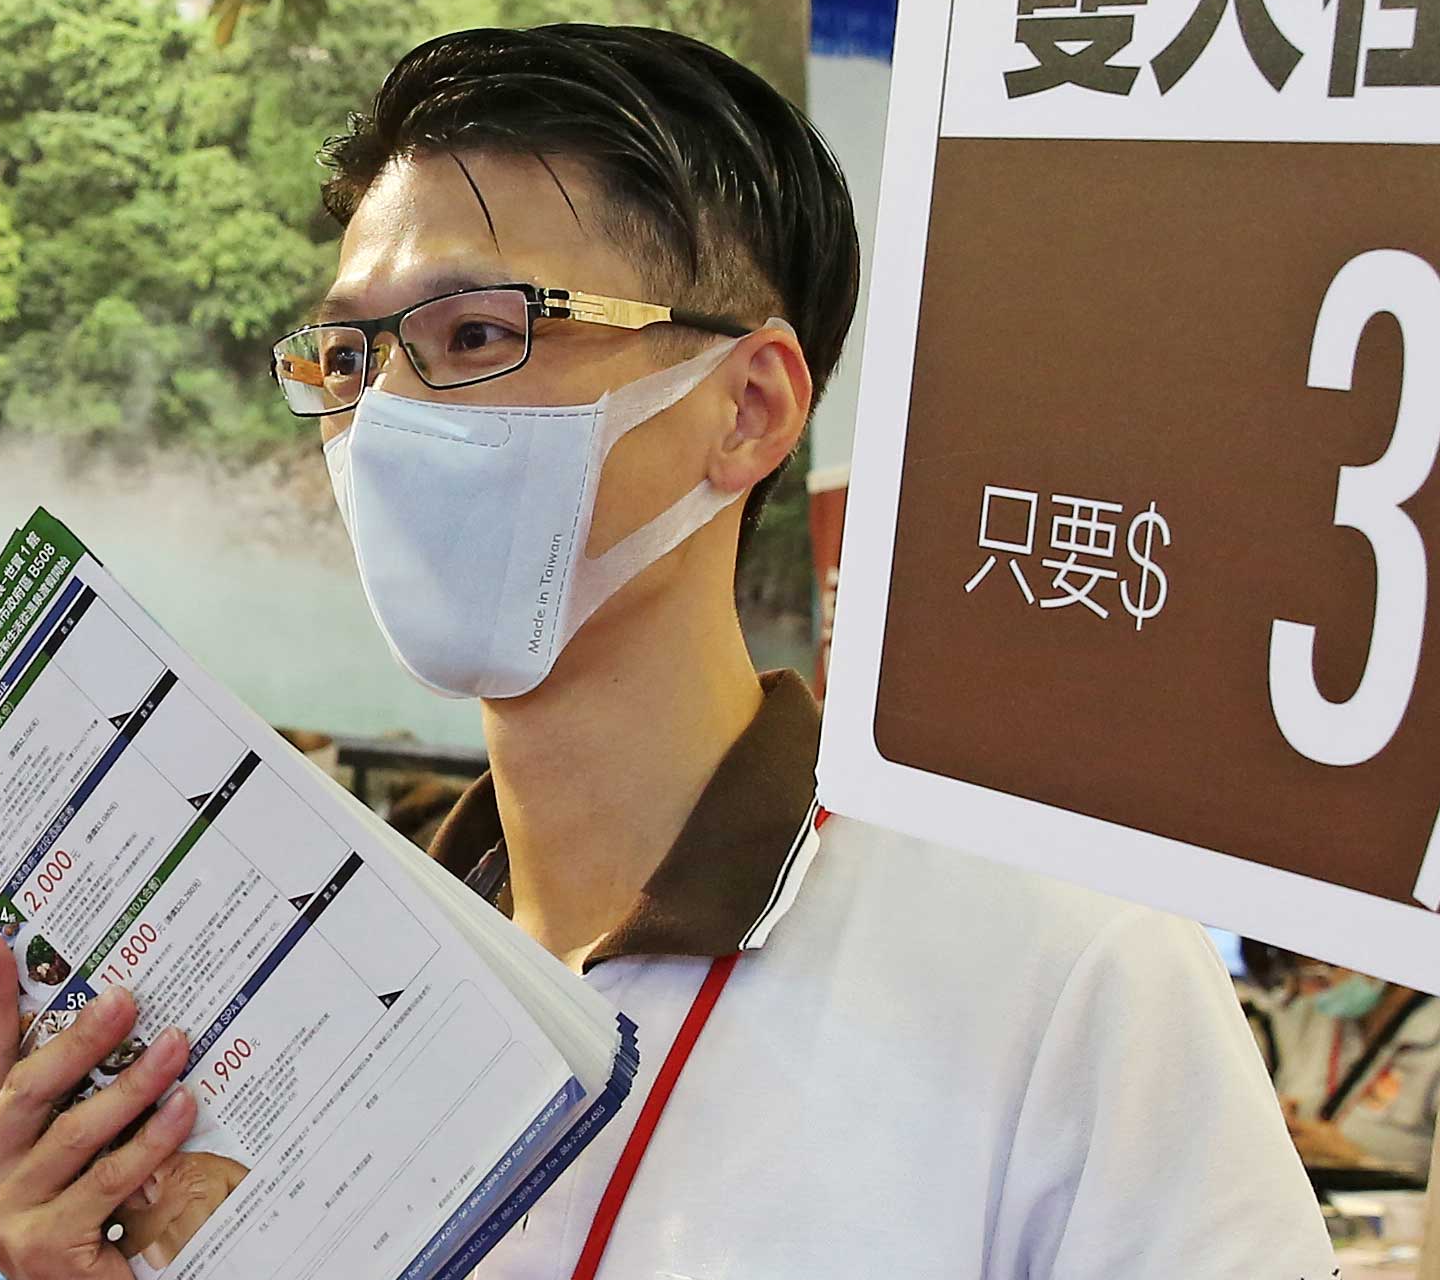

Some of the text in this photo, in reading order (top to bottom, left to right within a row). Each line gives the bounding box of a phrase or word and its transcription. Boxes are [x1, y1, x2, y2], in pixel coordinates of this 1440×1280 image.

[28, 543, 56, 578] B508
[528, 534, 562, 654] Made in Taiwan
[219, 1004, 240, 1026] SPA
